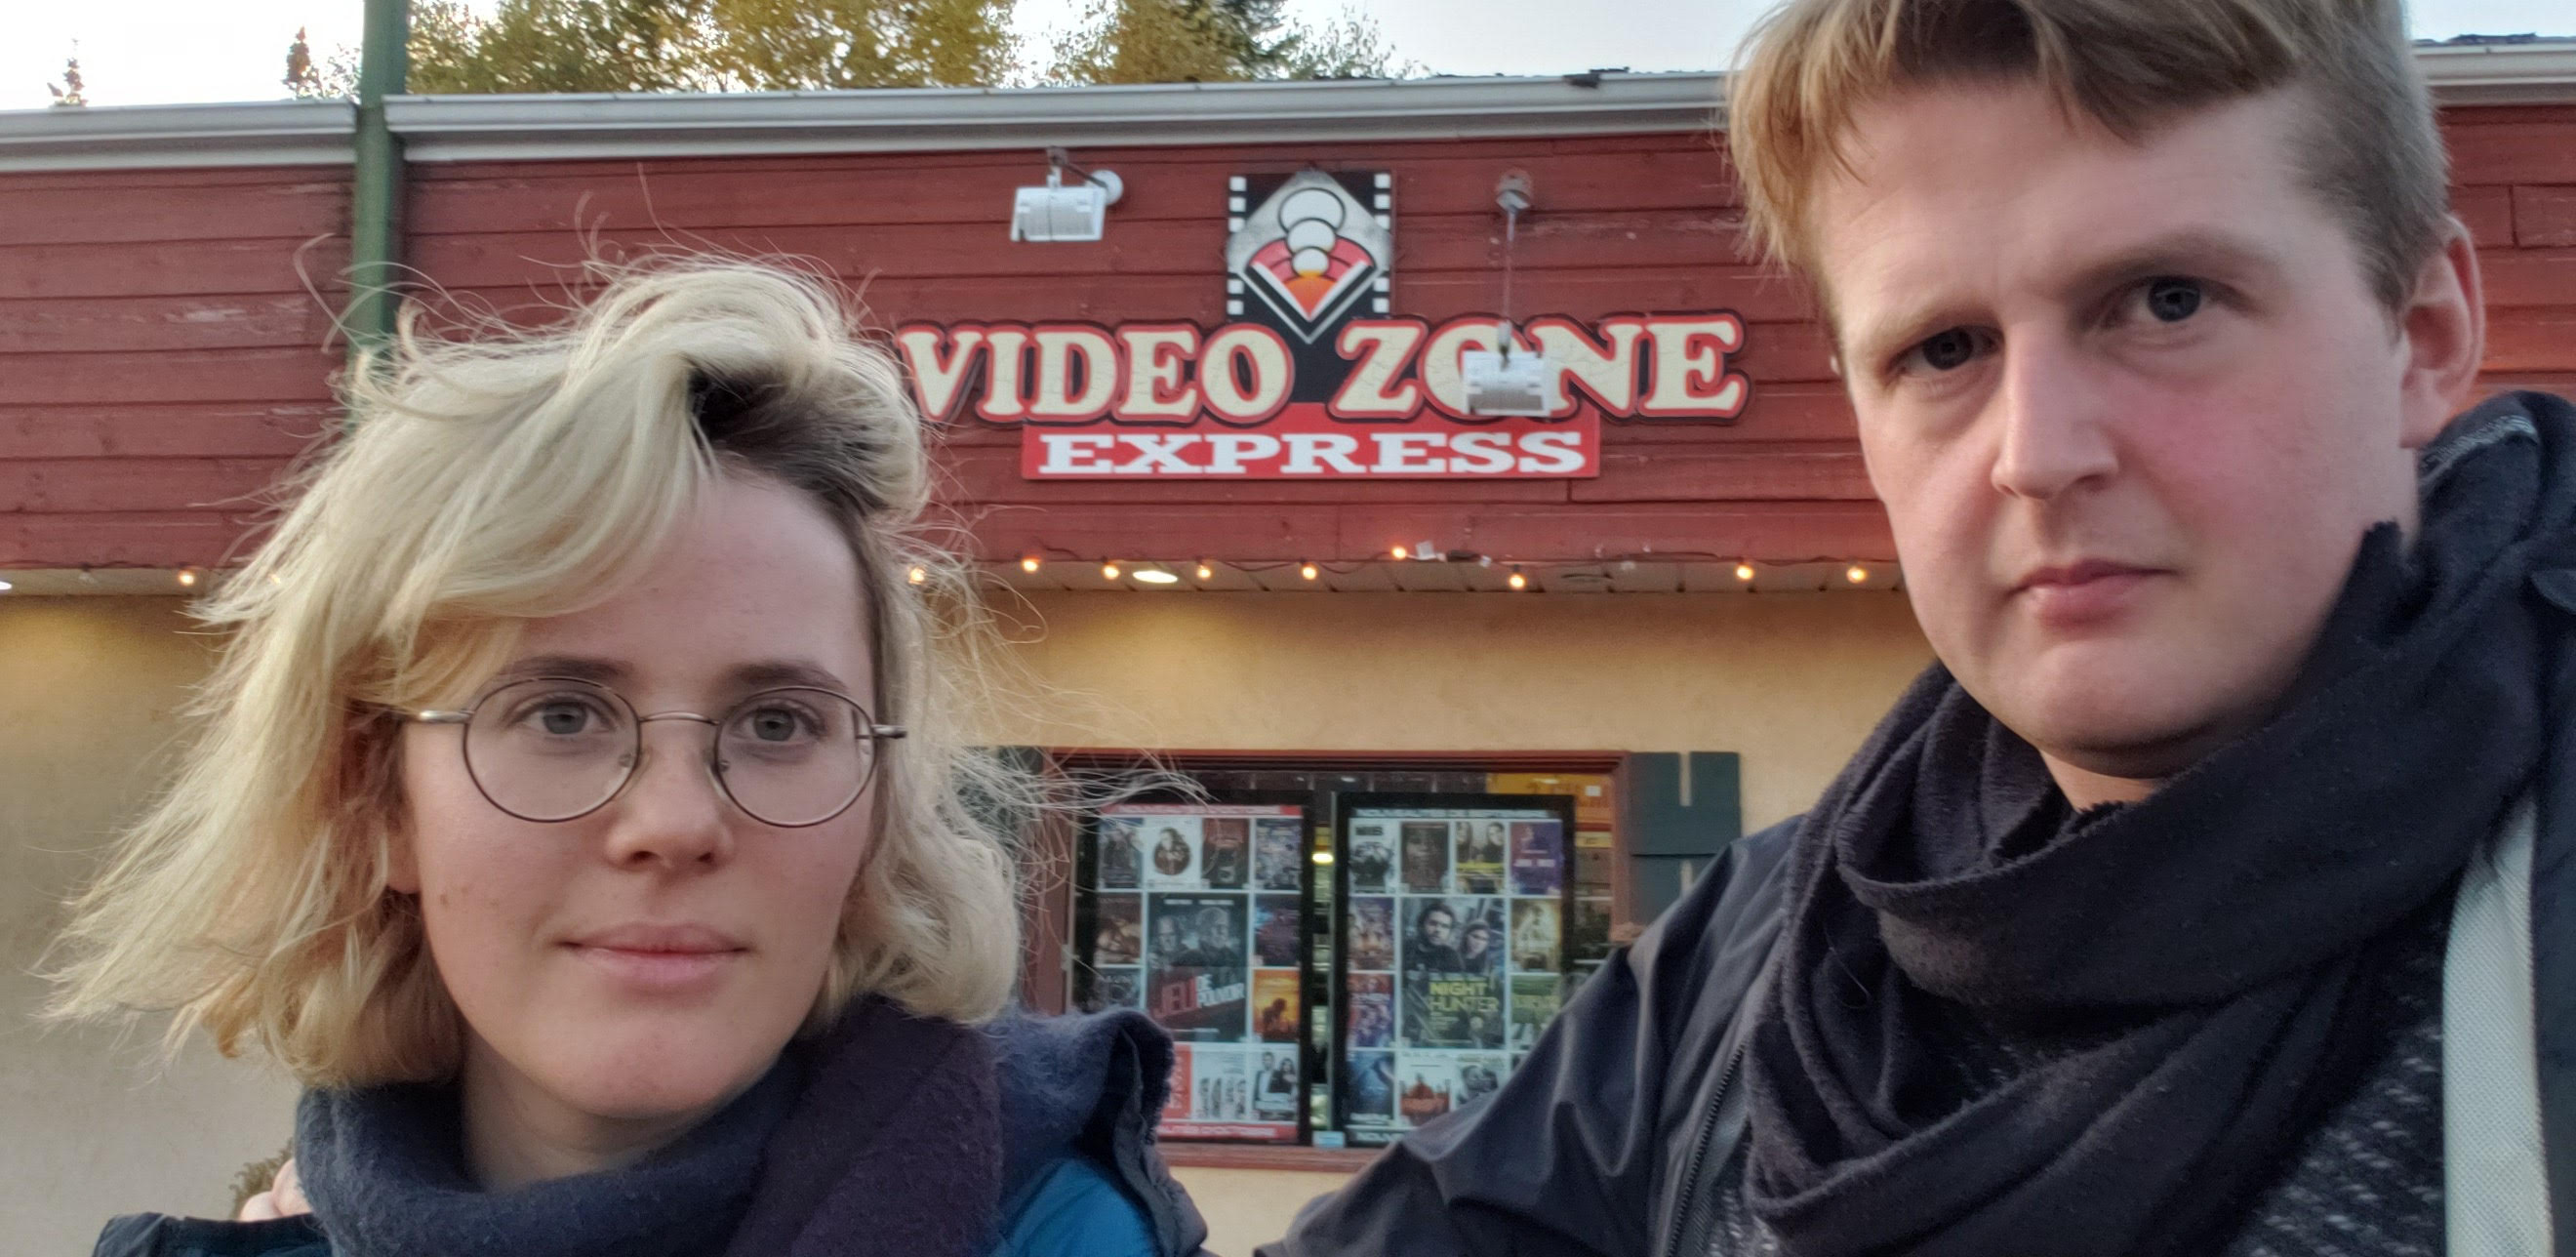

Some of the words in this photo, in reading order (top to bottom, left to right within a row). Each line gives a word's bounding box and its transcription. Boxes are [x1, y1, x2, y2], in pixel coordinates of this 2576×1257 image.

[897, 325, 1293, 422] VIDEO
[1037, 431, 1587, 475] EXPRESS
[1429, 982, 1488, 995] NIGHT
[1429, 995, 1500, 1013] HUNTER
